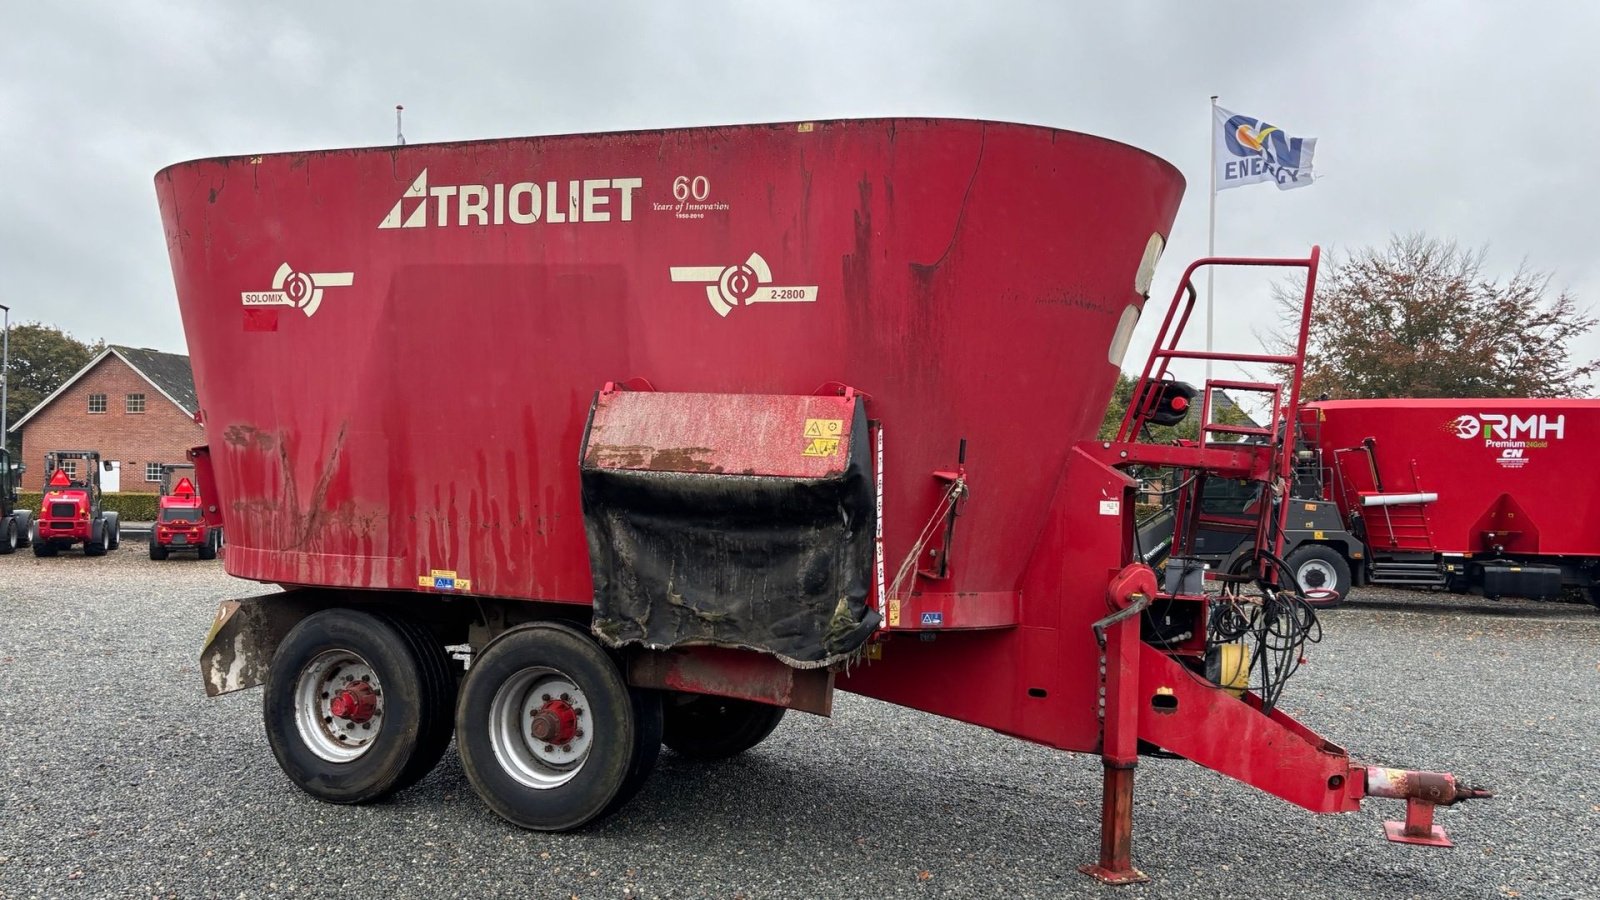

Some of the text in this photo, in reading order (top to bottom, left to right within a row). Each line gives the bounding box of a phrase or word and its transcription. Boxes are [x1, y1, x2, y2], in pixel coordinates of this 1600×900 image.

[673, 175, 711, 201] 60
[429, 177, 643, 228] TRIOLIET
[653, 201, 730, 213] Years of Innovation
[245, 293, 283, 303] SOLOMIX
[771, 289, 805, 299] 2-2800
[1479, 413, 1565, 439] RMH
[1485, 439, 1526, 448] Premium
[1502, 449, 1524, 458] CN
